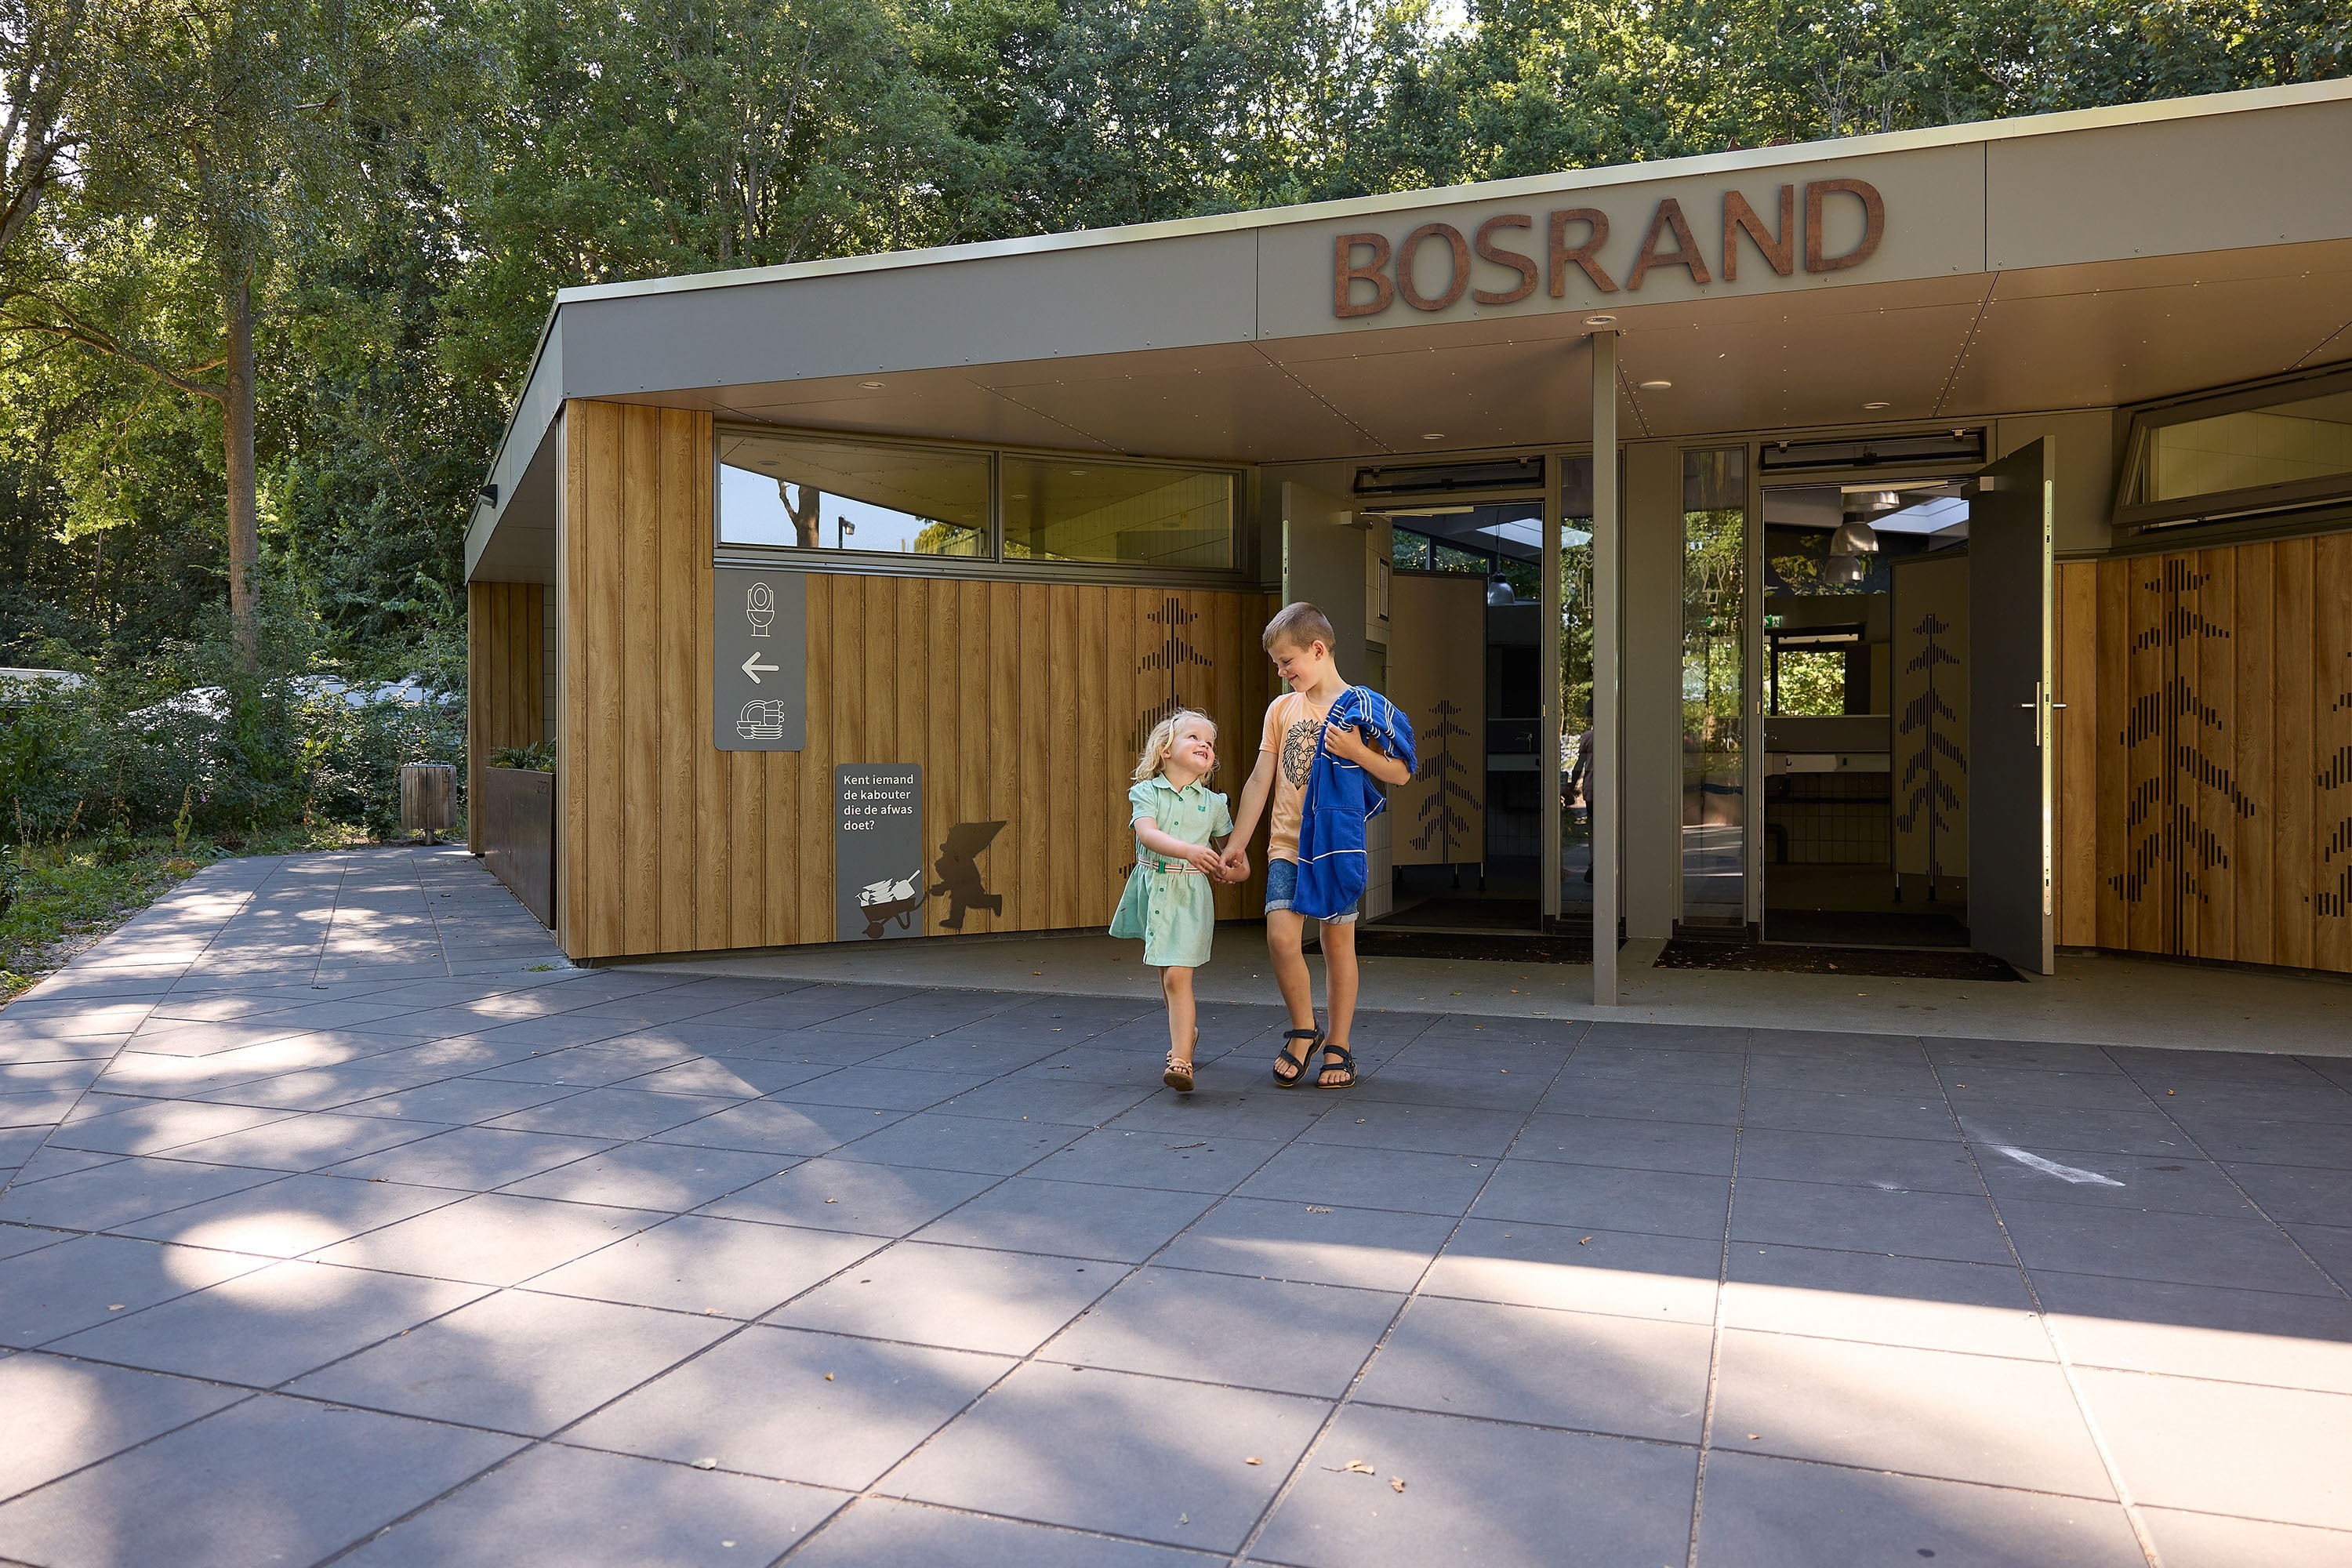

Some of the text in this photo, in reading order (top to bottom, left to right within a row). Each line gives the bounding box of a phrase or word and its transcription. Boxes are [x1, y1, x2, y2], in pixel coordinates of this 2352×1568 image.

[1334, 177, 1886, 318] BOSRAND
[844, 775, 913, 785] Kent iemand
[844, 789, 910, 800] de kabouter
[844, 804, 913, 815] die de afwas
[844, 820, 875, 830] doet?
